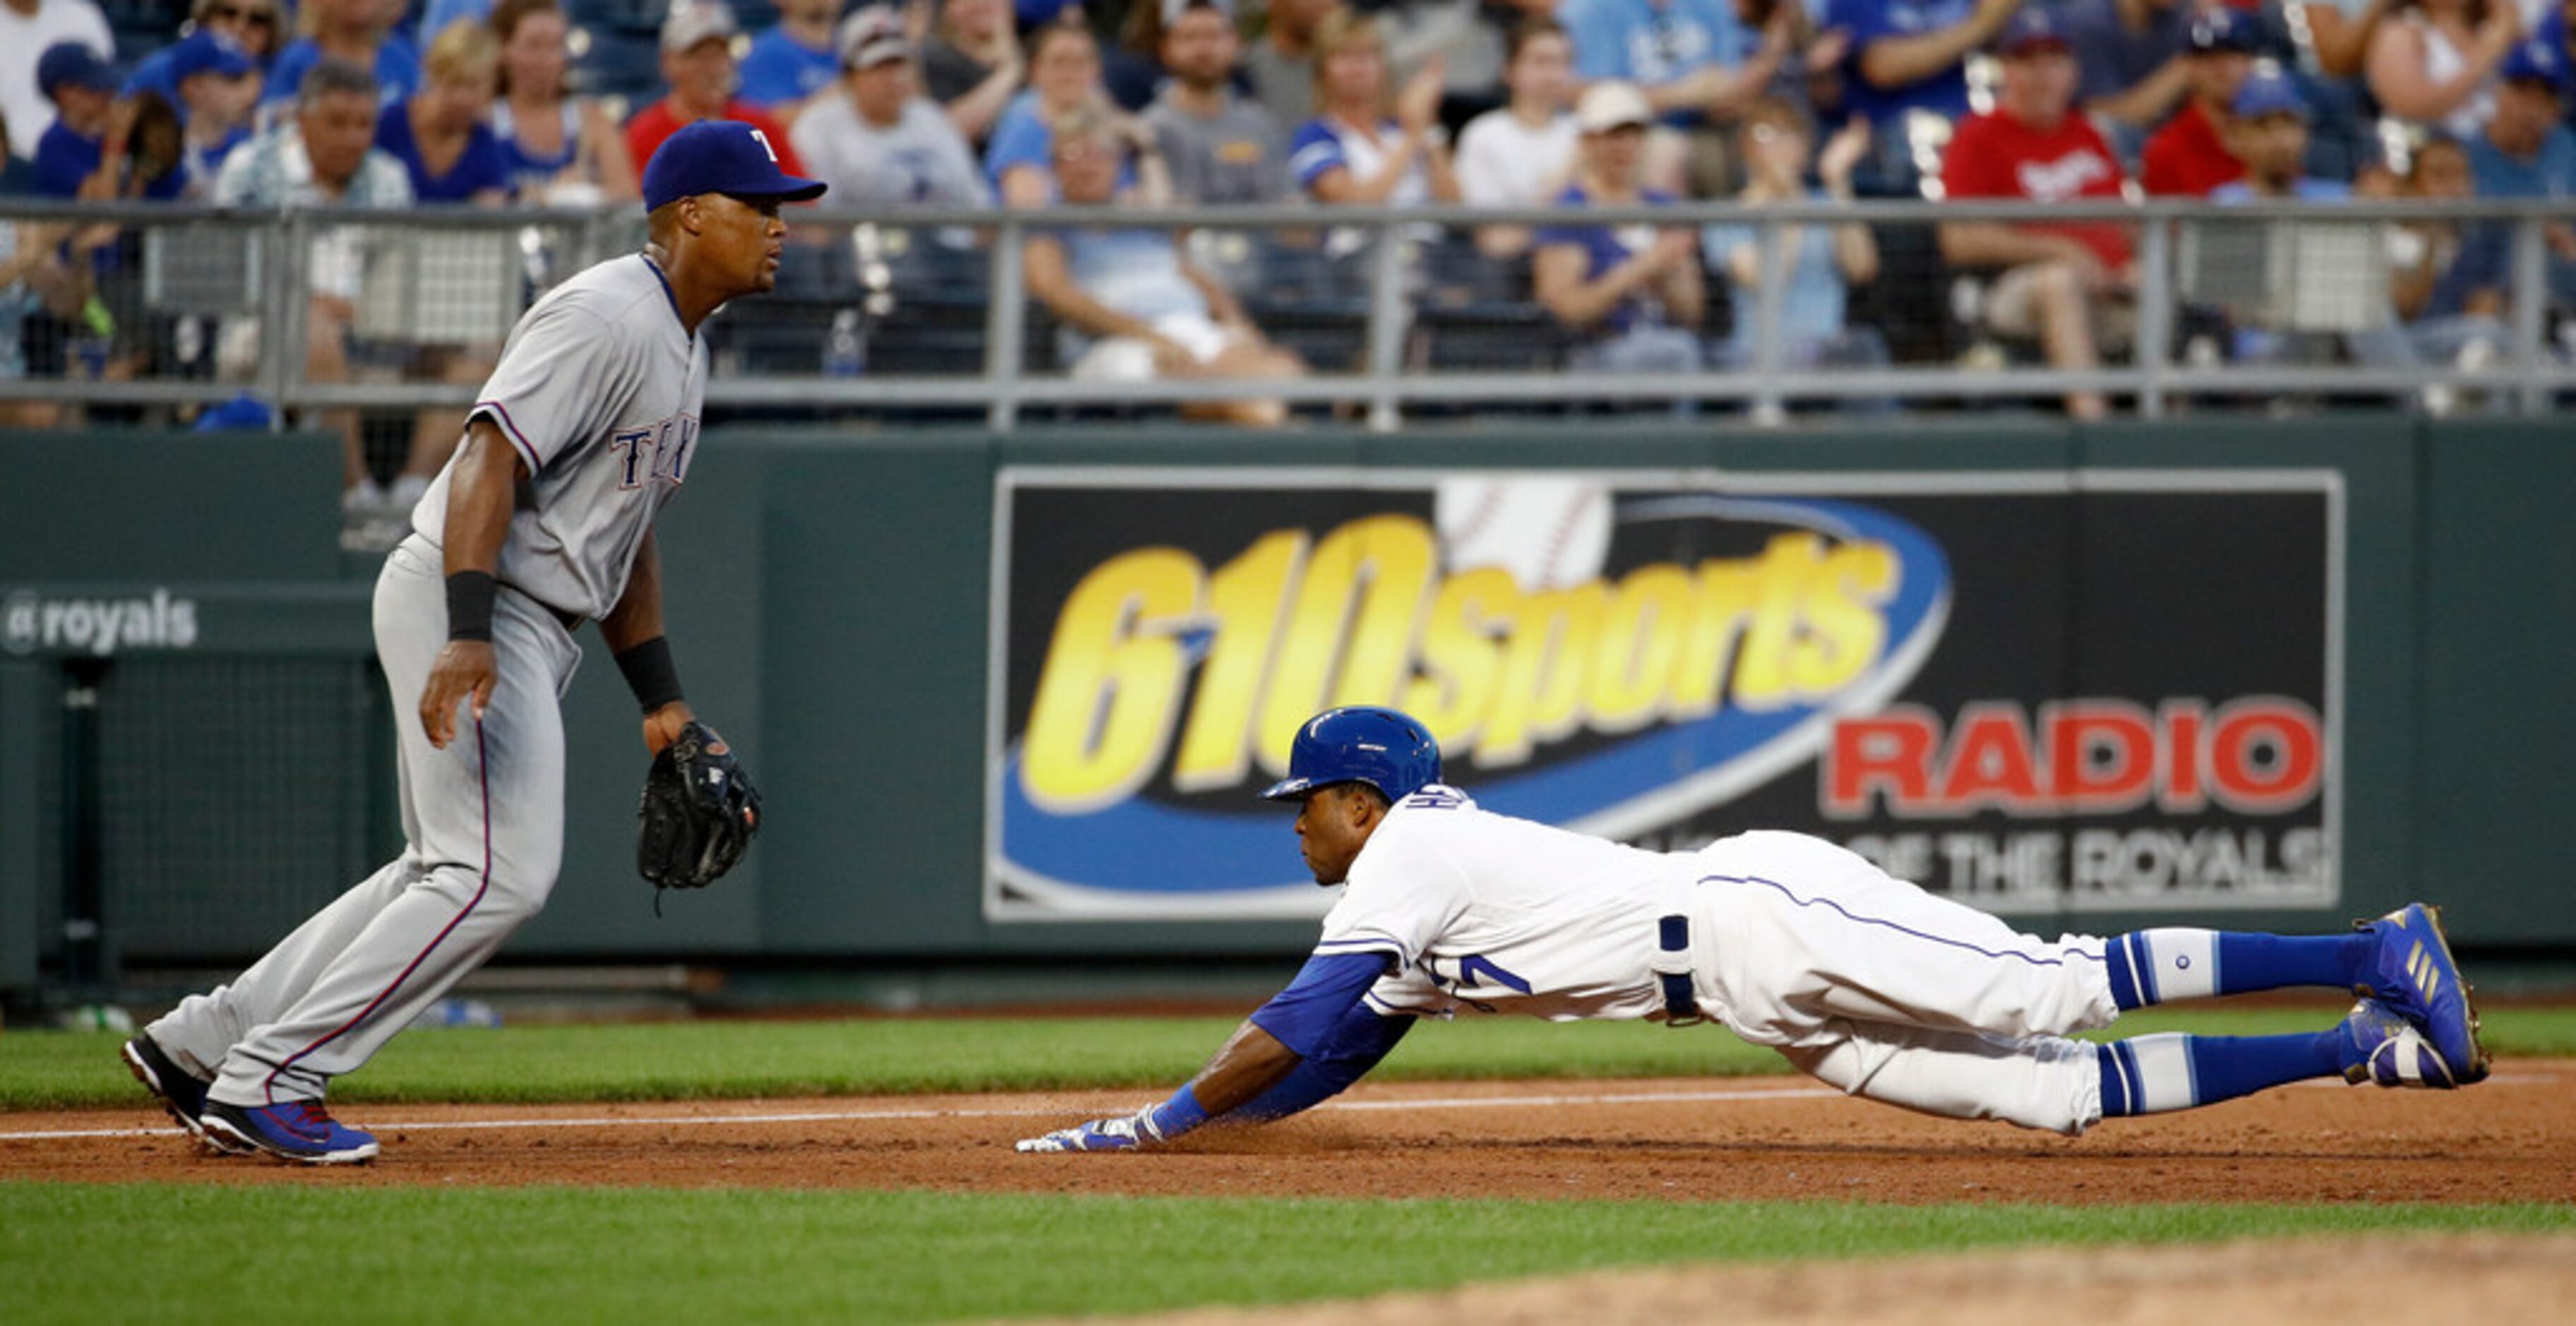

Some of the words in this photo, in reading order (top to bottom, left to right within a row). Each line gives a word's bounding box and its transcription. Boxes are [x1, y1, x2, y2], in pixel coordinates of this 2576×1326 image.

[748, 129, 779, 162] T
[3, 587, 199, 656] @royals
[1021, 513, 1439, 816] 610
[1820, 699, 2325, 816] RADIO
[1939, 832, 2061, 895] THE
[2073, 828, 2327, 891] ROYALS
